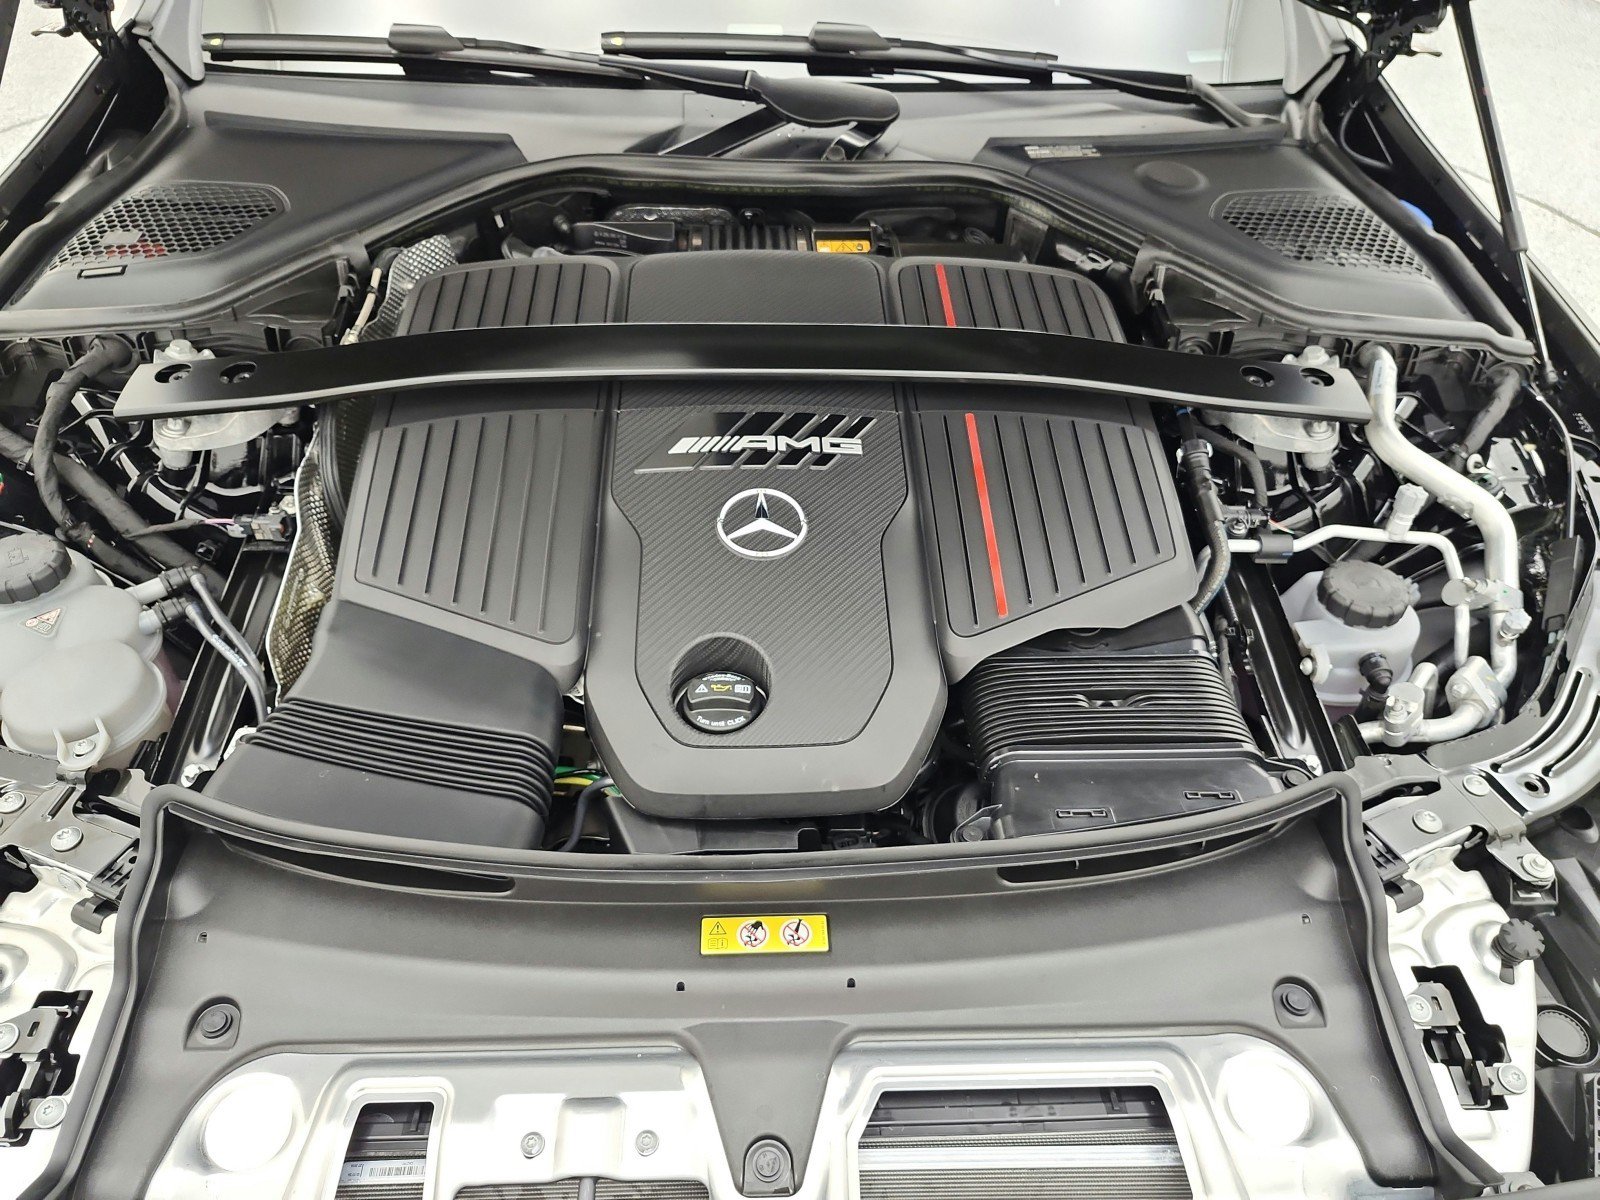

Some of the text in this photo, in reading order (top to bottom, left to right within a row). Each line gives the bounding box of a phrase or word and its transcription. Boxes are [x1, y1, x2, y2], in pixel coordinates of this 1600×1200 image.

[731, 436, 863, 456] AMG
[696, 715, 710, 725] Turn
[726, 715, 746, 726] CLICK
